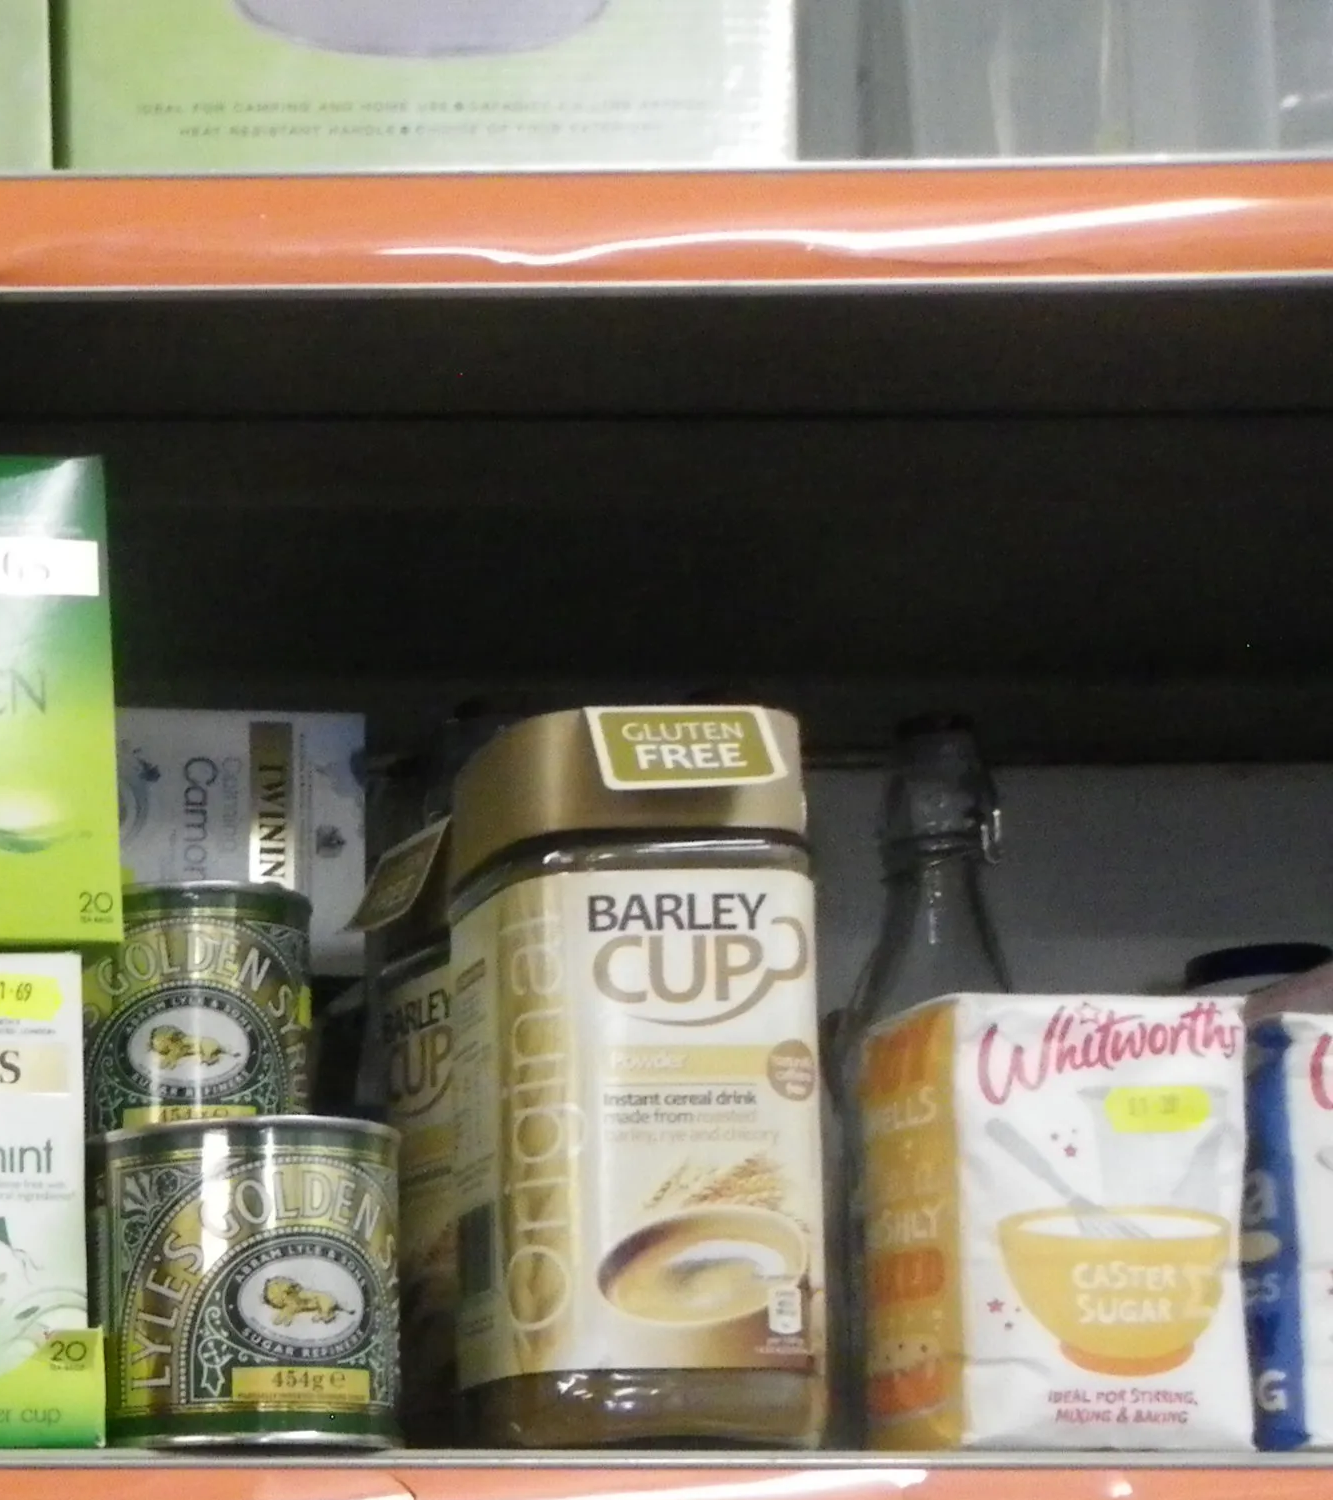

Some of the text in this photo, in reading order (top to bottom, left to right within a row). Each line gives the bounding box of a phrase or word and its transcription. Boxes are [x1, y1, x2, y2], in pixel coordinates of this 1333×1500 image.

[621, 720, 745, 744] GLUTEN
[635, 743, 747, 771] FREE
[79, 892, 114, 914] 20
[587, 893, 767, 932] BARLEY
[97, 931, 272, 997] GOLDEN
[591, 928, 783, 1006] CUP
[664, 1090, 758, 1106] cereal drink
[1072, 1266, 1176, 1290] CASTER
[132, 1233, 205, 1391] LYLE'S
[1078, 1299, 1172, 1324] SUGAR
[49, 1340, 87, 1362] 20
[21, 1407, 62, 1425] cup
[1115, 1408, 1129, 1423] &
